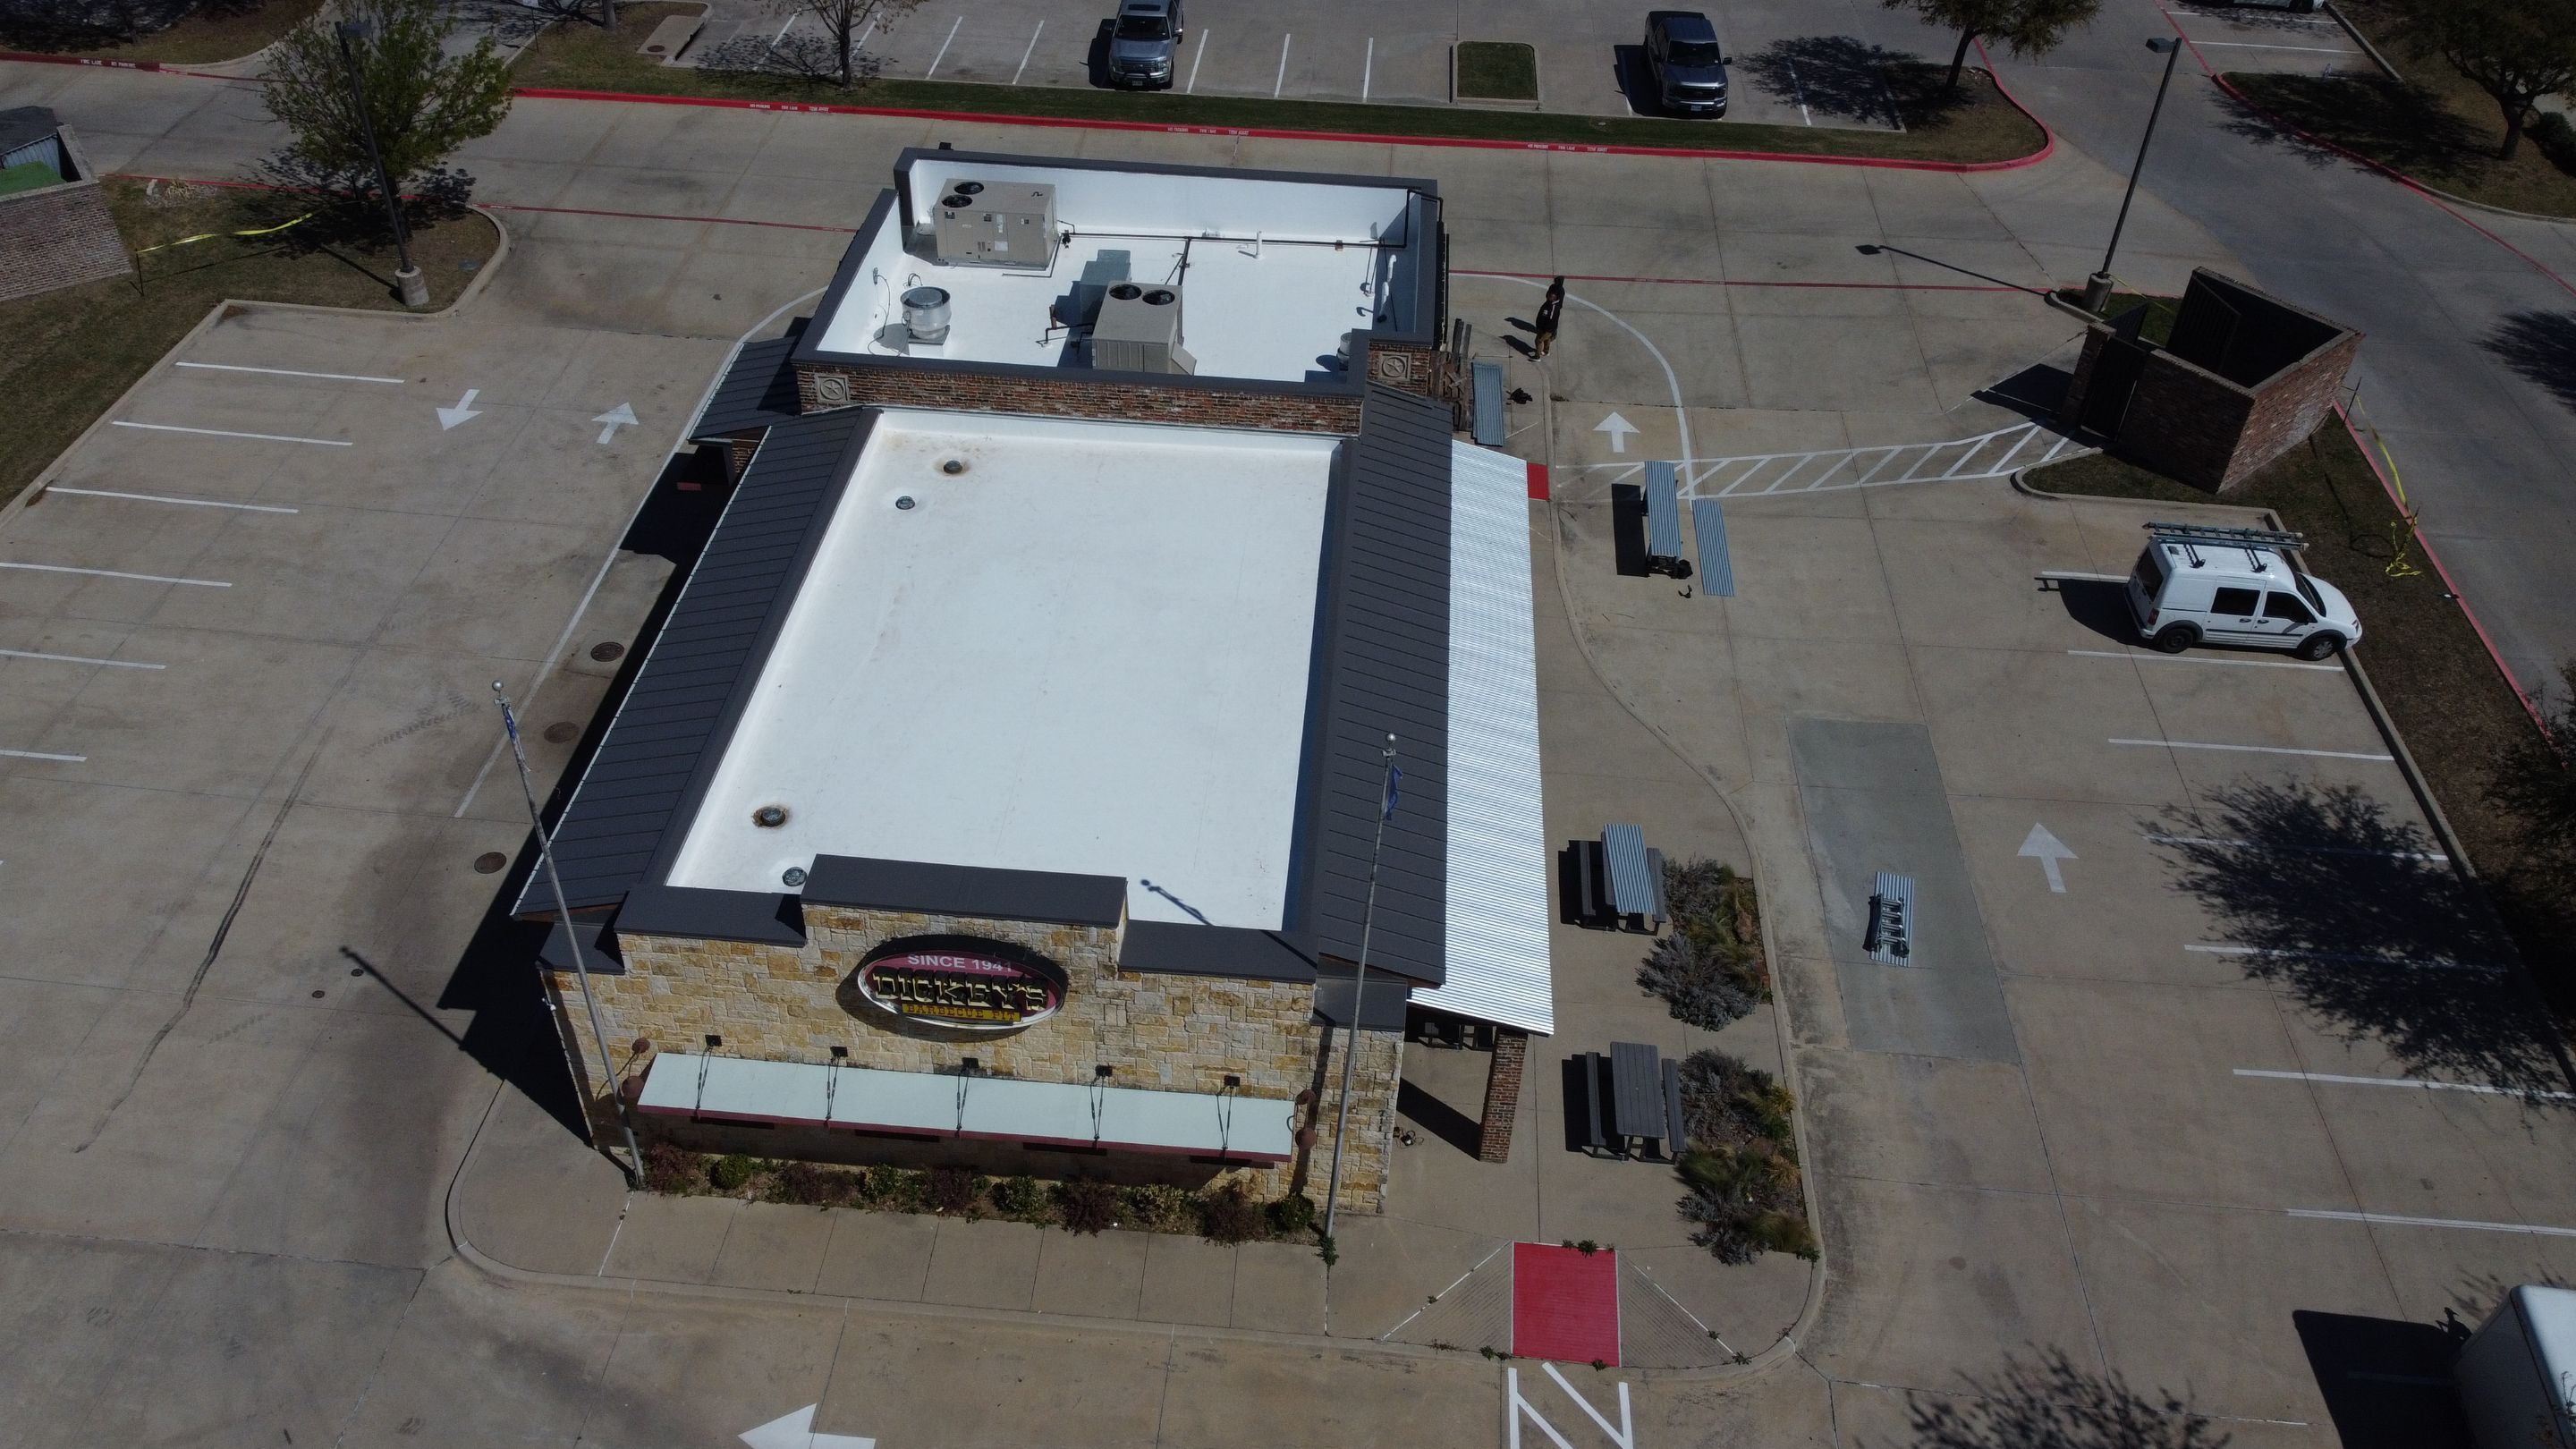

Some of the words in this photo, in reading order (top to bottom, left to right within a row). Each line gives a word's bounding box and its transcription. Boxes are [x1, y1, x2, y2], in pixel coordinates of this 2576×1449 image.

[907, 954, 966, 969] SINCE
[972, 958, 1013, 972] 1941
[871, 970, 1050, 1012] DICKEY'S
[907, 1004, 985, 1018] BARBECUE
[992, 1010, 1016, 1021] PIT
